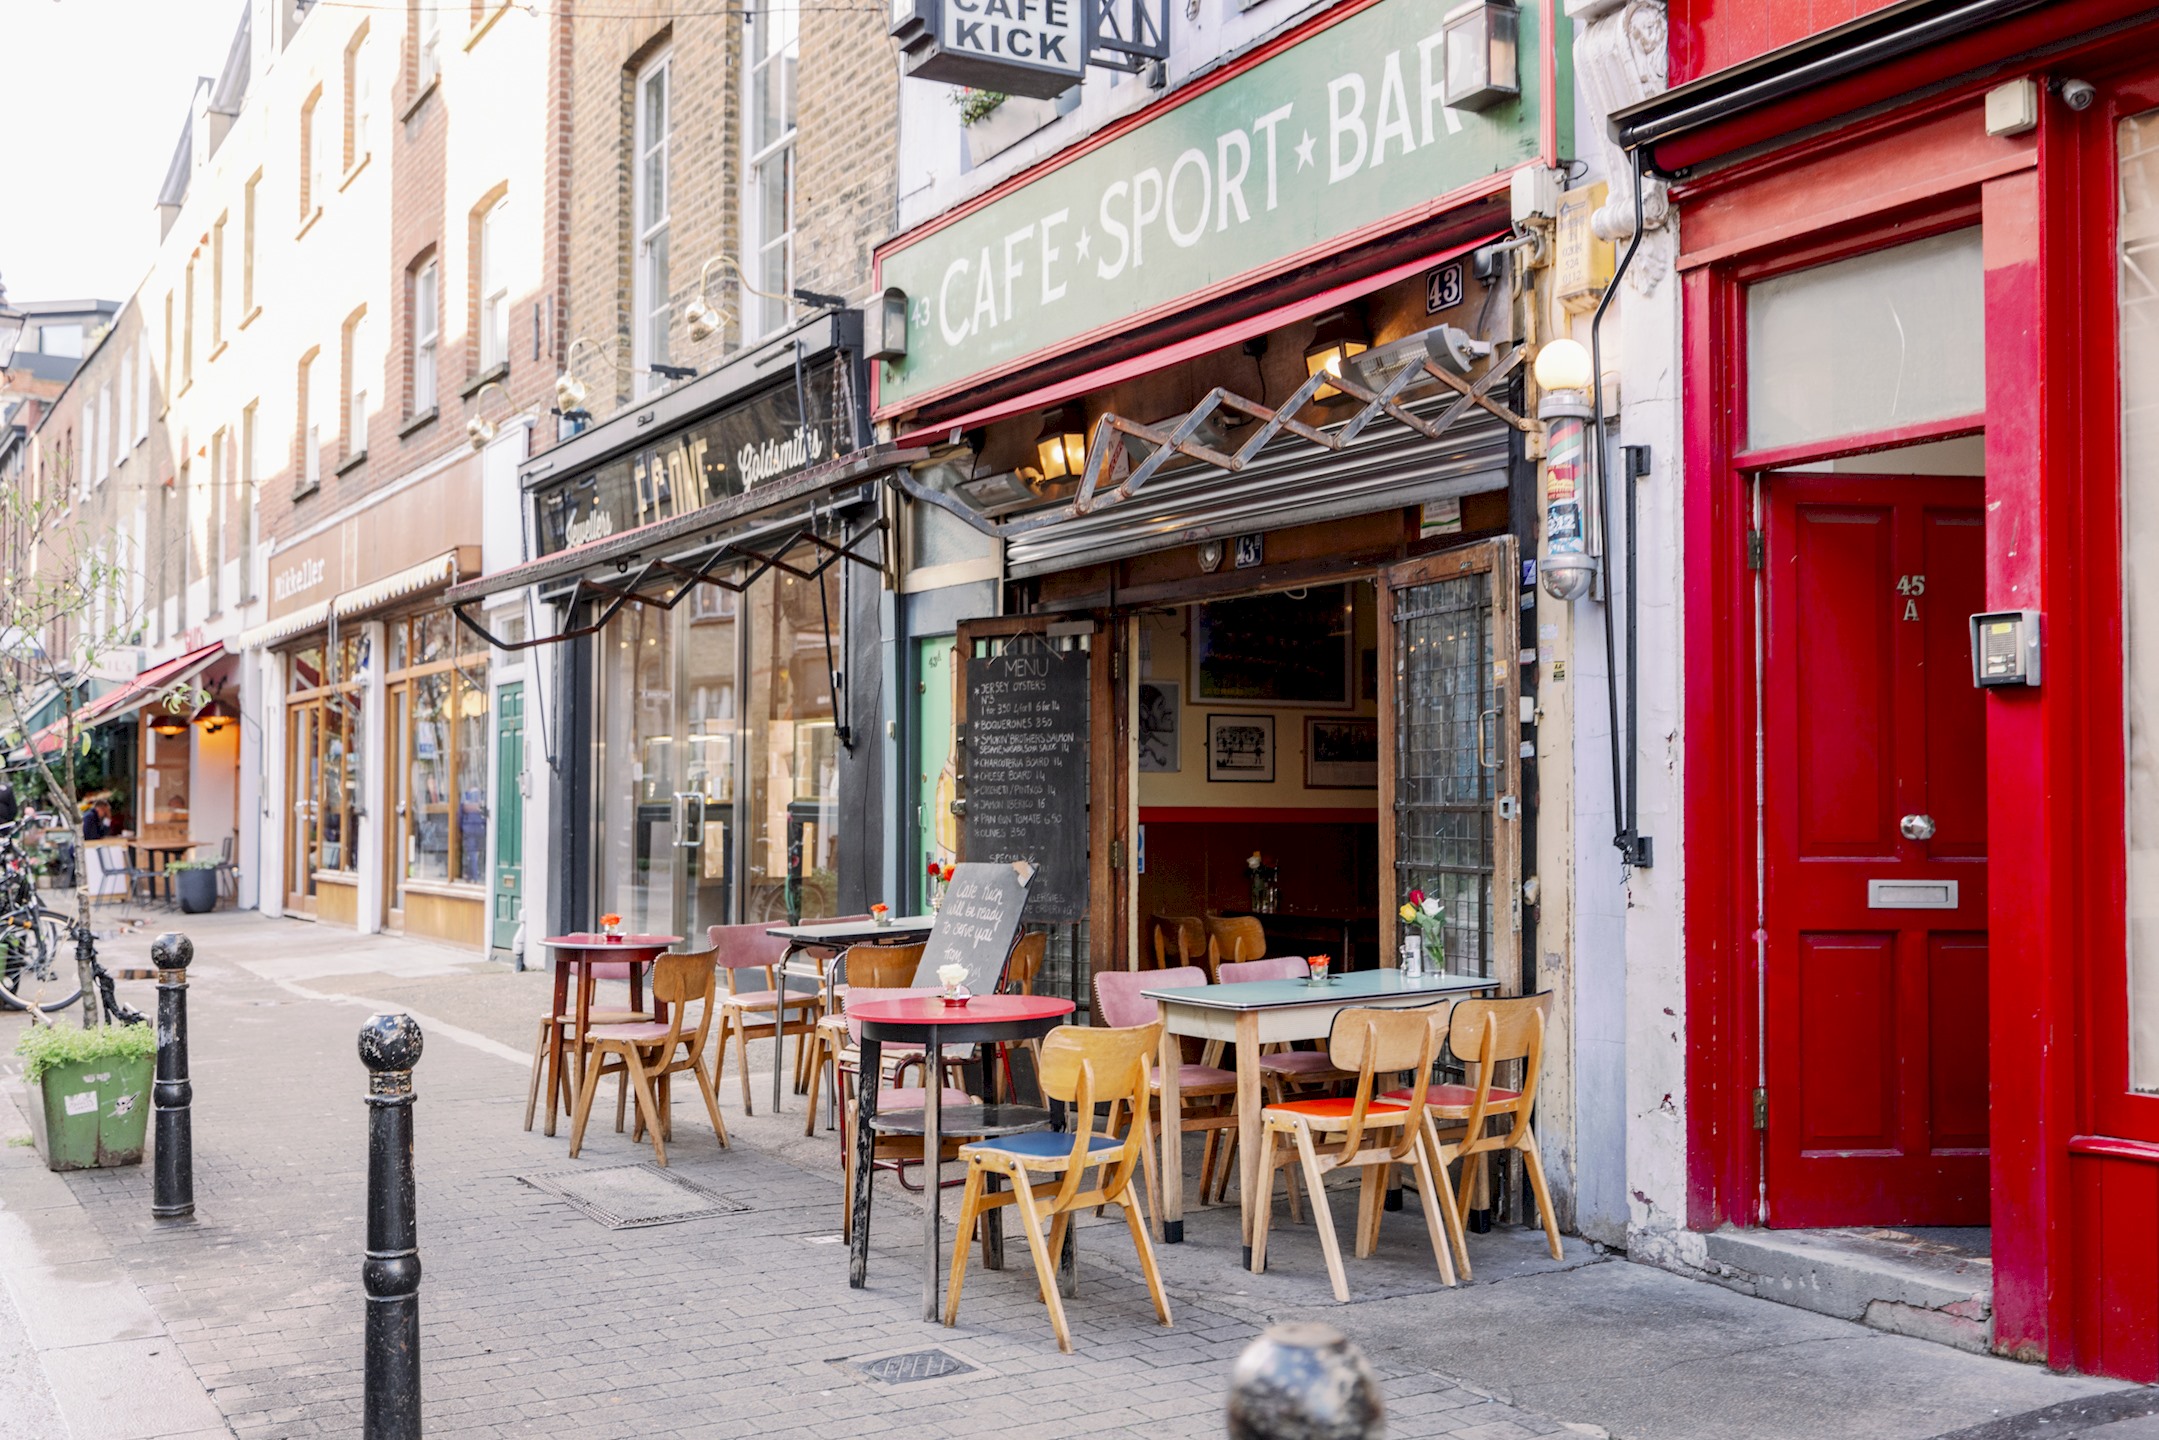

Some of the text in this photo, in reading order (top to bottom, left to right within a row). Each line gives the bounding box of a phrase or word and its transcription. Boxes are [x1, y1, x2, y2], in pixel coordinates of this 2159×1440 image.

[956, 18, 1068, 64] KICK
[939, 29, 1463, 346] CAFE SPORT BAR
[1430, 268, 1459, 307] 43
[910, 296, 931, 329] 43
[737, 424, 823, 493] Goldsmiths
[1896, 575, 1925, 596] 45
[1903, 599, 1920, 621] A
[1005, 658, 1049, 677] MENU
[980, 680, 1047, 695] JERSEY OYSTERS
[980, 717, 1032, 731] BOQUERONES
[1061, 743, 1070, 753] 14
[1025, 756, 1050, 768] BOARD
[1053, 756, 1063, 768] 14
[980, 770, 1046, 782] CHEESE BOARD 14
[1047, 784, 1056, 797] 14
[1037, 797, 1046, 809] 16
[980, 813, 997, 825] PAN
[1013, 813, 1041, 825] TOMATE
[980, 828, 1007, 838] OLIVES
[946, 900, 963, 918] will
[965, 904, 977, 918] be
[976, 907, 1005, 932] ready
[952, 921, 974, 938] serve
[973, 925, 994, 949] you
